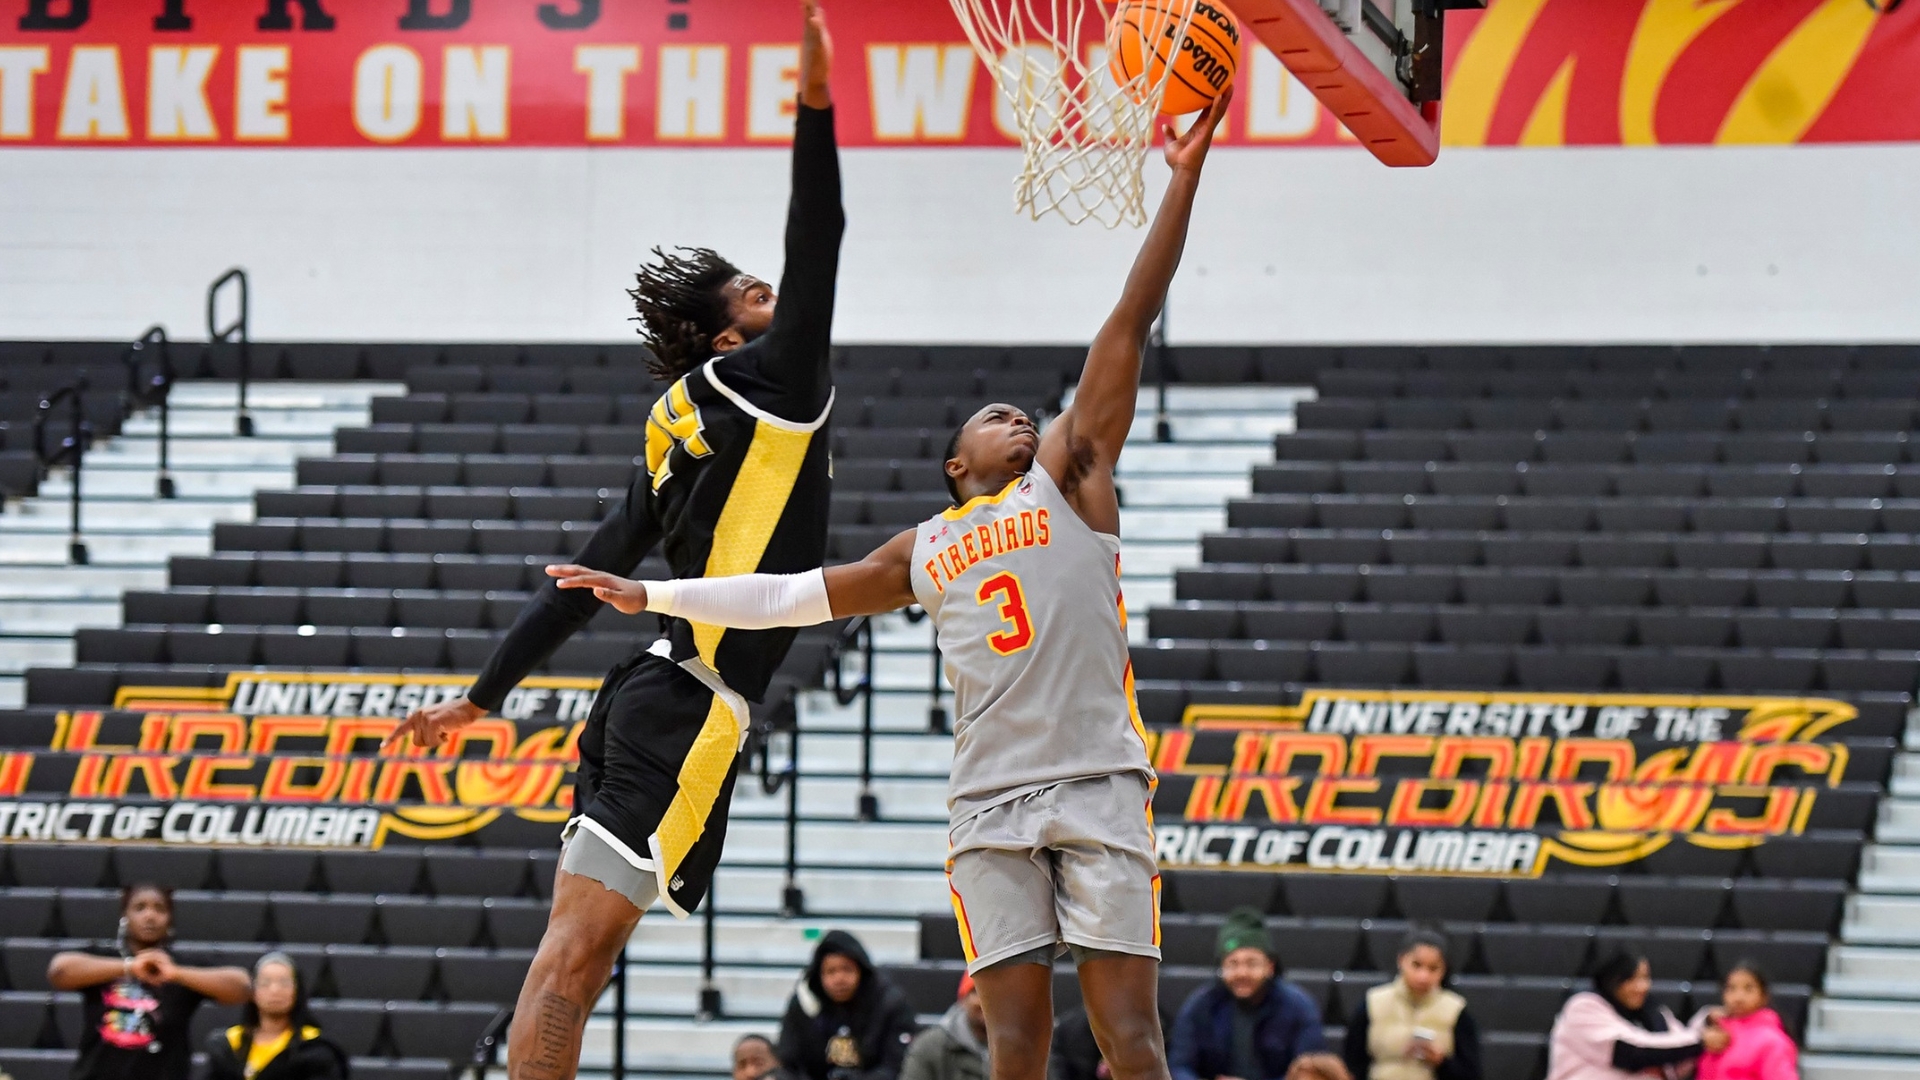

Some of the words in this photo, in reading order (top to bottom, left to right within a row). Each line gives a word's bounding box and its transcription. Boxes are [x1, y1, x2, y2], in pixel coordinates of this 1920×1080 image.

[0, 44, 292, 141] TAKE
[350, 43, 512, 141] ON
[573, 44, 801, 141] THE
[924, 508, 1050, 594] FIREBIRDS
[975, 570, 1036, 656] 3
[232, 679, 471, 718] UNIVERSIT
[502, 688, 551, 720] OF
[556, 688, 600, 722] TH
[1307, 697, 1588, 738] UNIVERSITY
[1595, 705, 1649, 740] OF
[1653, 707, 1731, 742] THE
[111, 805, 163, 840] OF
[161, 797, 380, 847] COLUMBIA
[1155, 824, 1258, 866] RICT
[1253, 828, 1309, 866] OF
[1306, 824, 1544, 874] COLUMBIA
